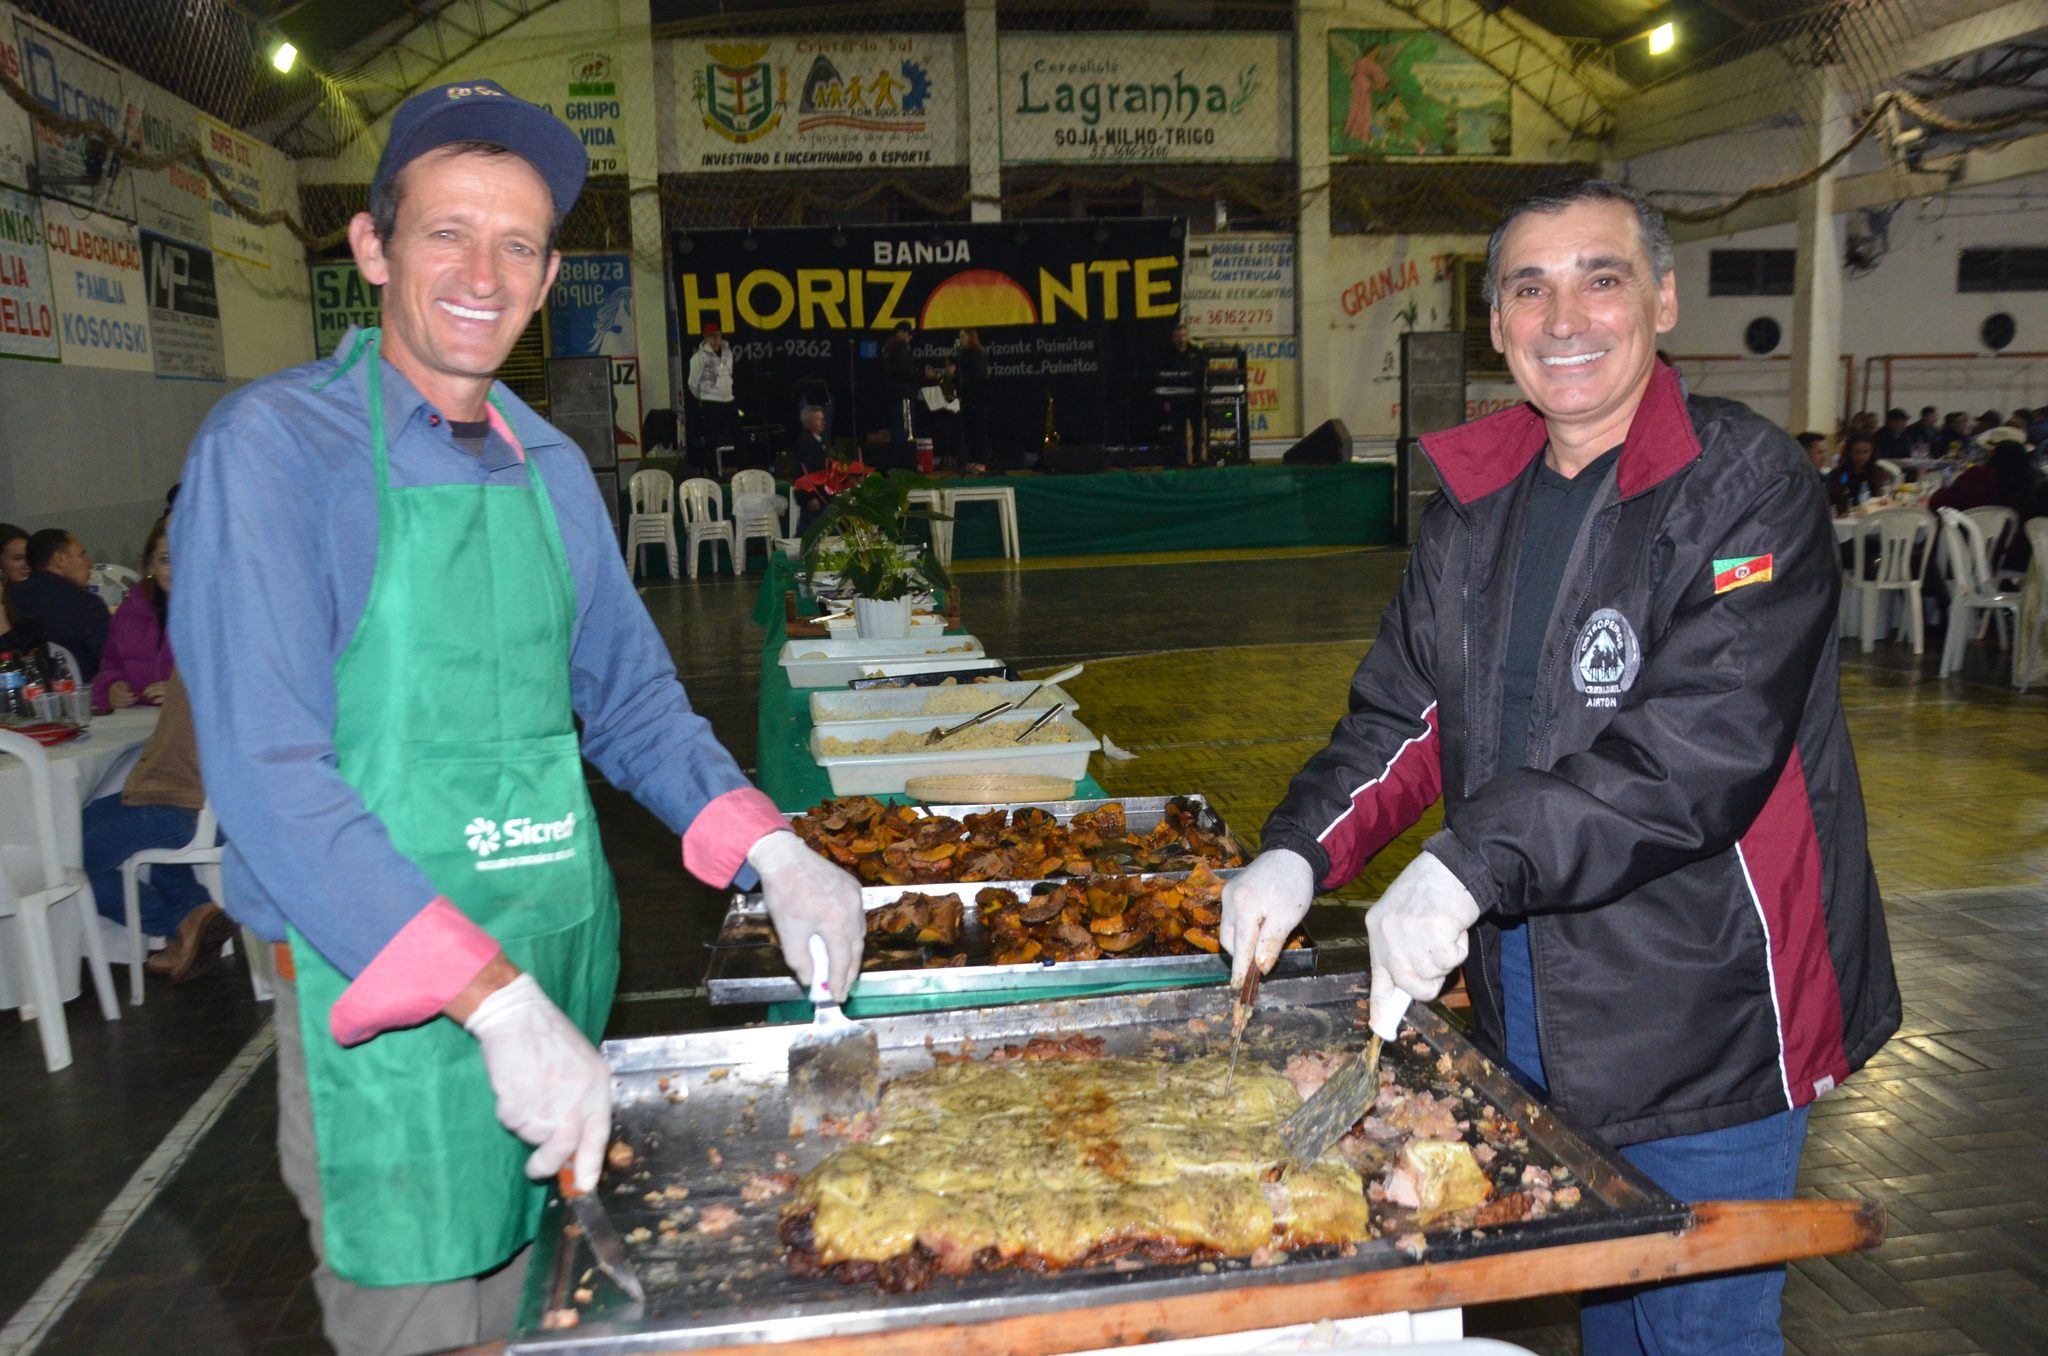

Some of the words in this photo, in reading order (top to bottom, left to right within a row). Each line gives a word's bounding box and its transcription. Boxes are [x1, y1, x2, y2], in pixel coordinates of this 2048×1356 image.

[1016, 68, 1228, 126] Lagranha
[565, 101, 621, 120] GRUPO
[579, 127, 616, 146] VIDA
[701, 152, 770, 166] INVESTINDO
[773, 152, 781, 164] E
[784, 150, 863, 165] INCENTIVANDO
[869, 150, 877, 163] O
[881, 149, 932, 163] ESPORTE
[873, 239, 971, 265] BANDA
[559, 260, 624, 282] Beleza
[1341, 259, 1420, 317] GRANJA
[1585, 696, 1618, 708] AIRTON
